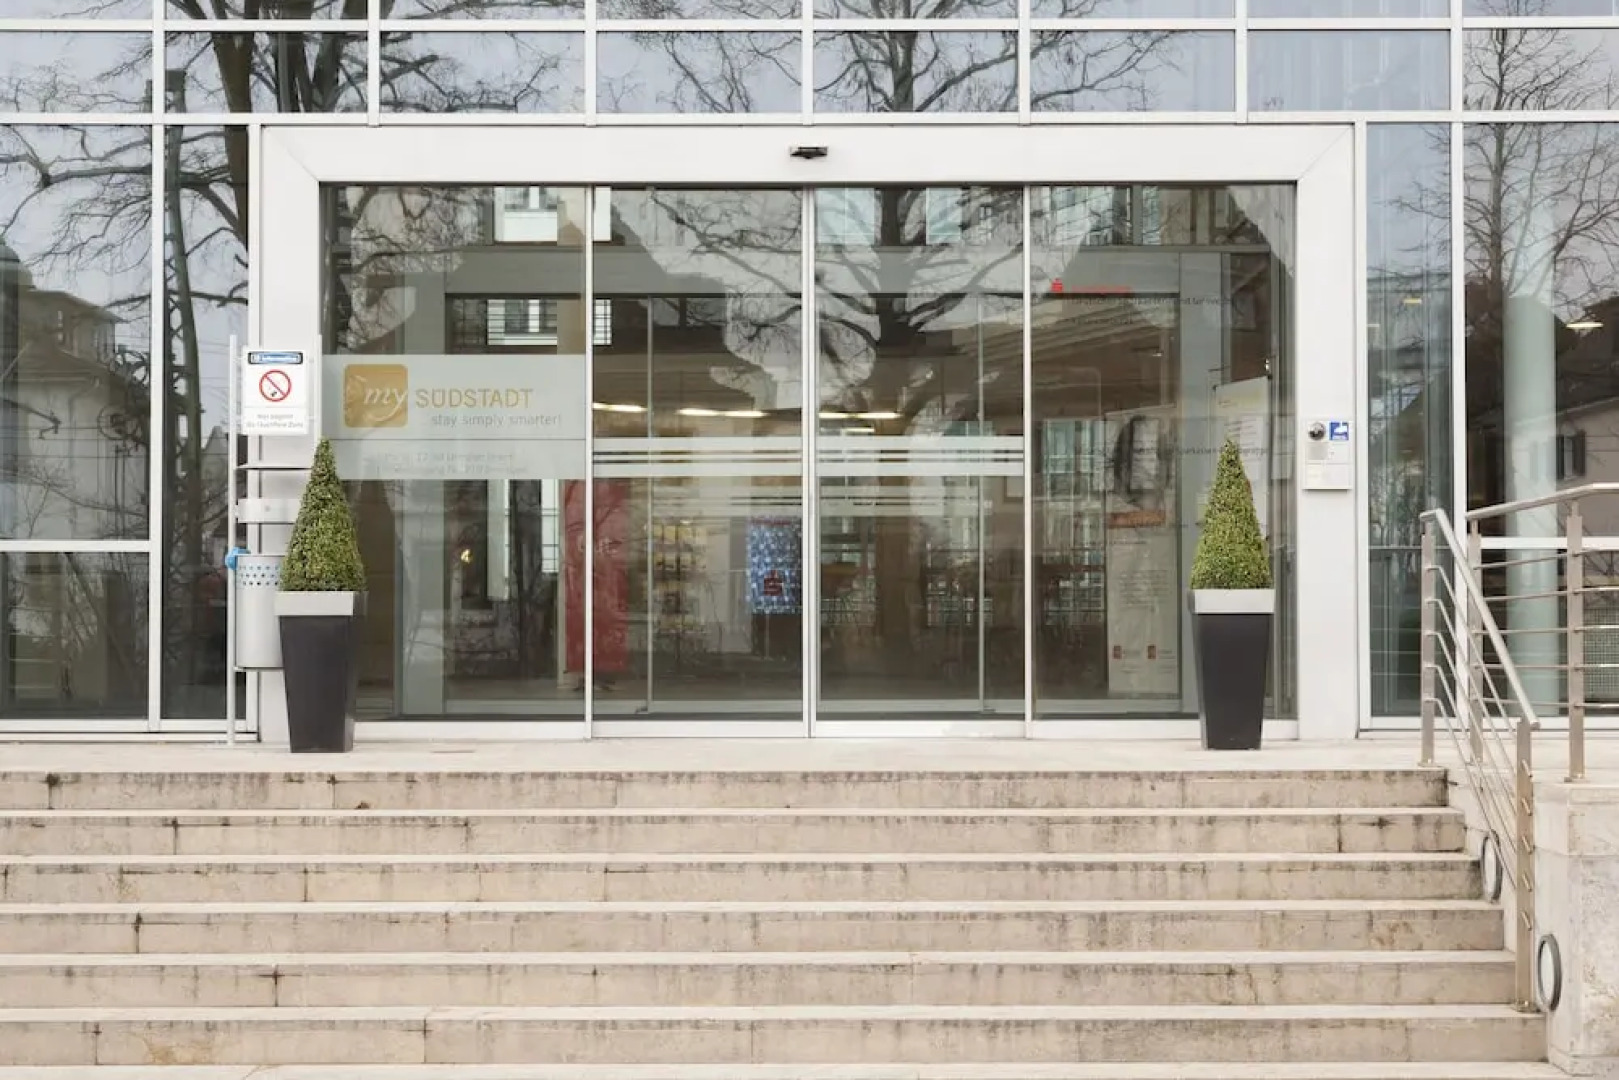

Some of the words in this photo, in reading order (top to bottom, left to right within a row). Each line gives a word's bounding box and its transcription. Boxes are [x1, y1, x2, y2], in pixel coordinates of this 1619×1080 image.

[363, 387, 408, 422] my
[415, 388, 534, 409] SÜDSTADT
[431, 413, 457, 427] stay
[461, 414, 504, 428] simply
[509, 414, 563, 426] smarter!
